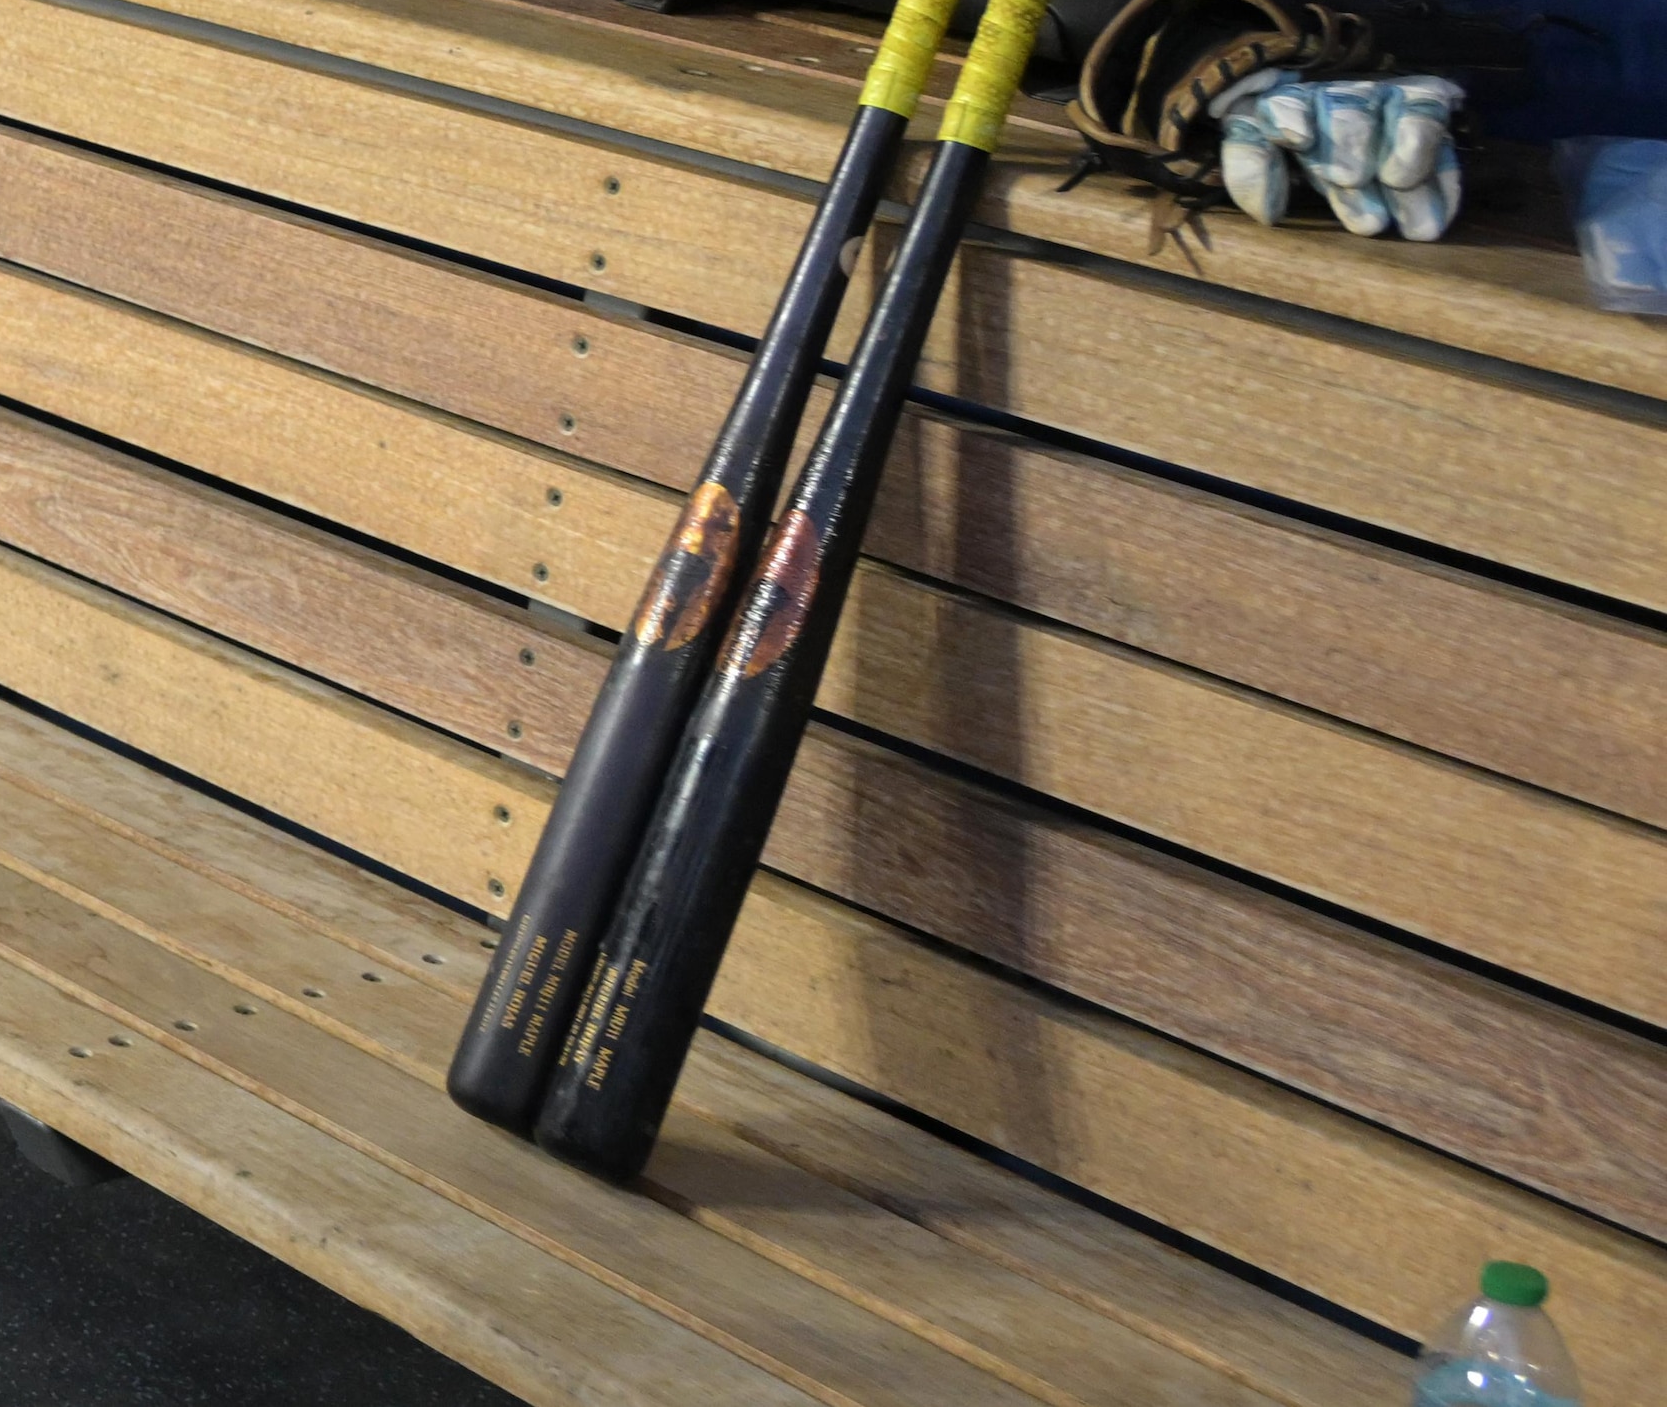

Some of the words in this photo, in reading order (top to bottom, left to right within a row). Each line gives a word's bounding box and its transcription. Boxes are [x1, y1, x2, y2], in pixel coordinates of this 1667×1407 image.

[621, 958, 648, 999] Model
[517, 1013, 544, 1058] MAPLE
[585, 1046, 614, 1091] MAPLE
